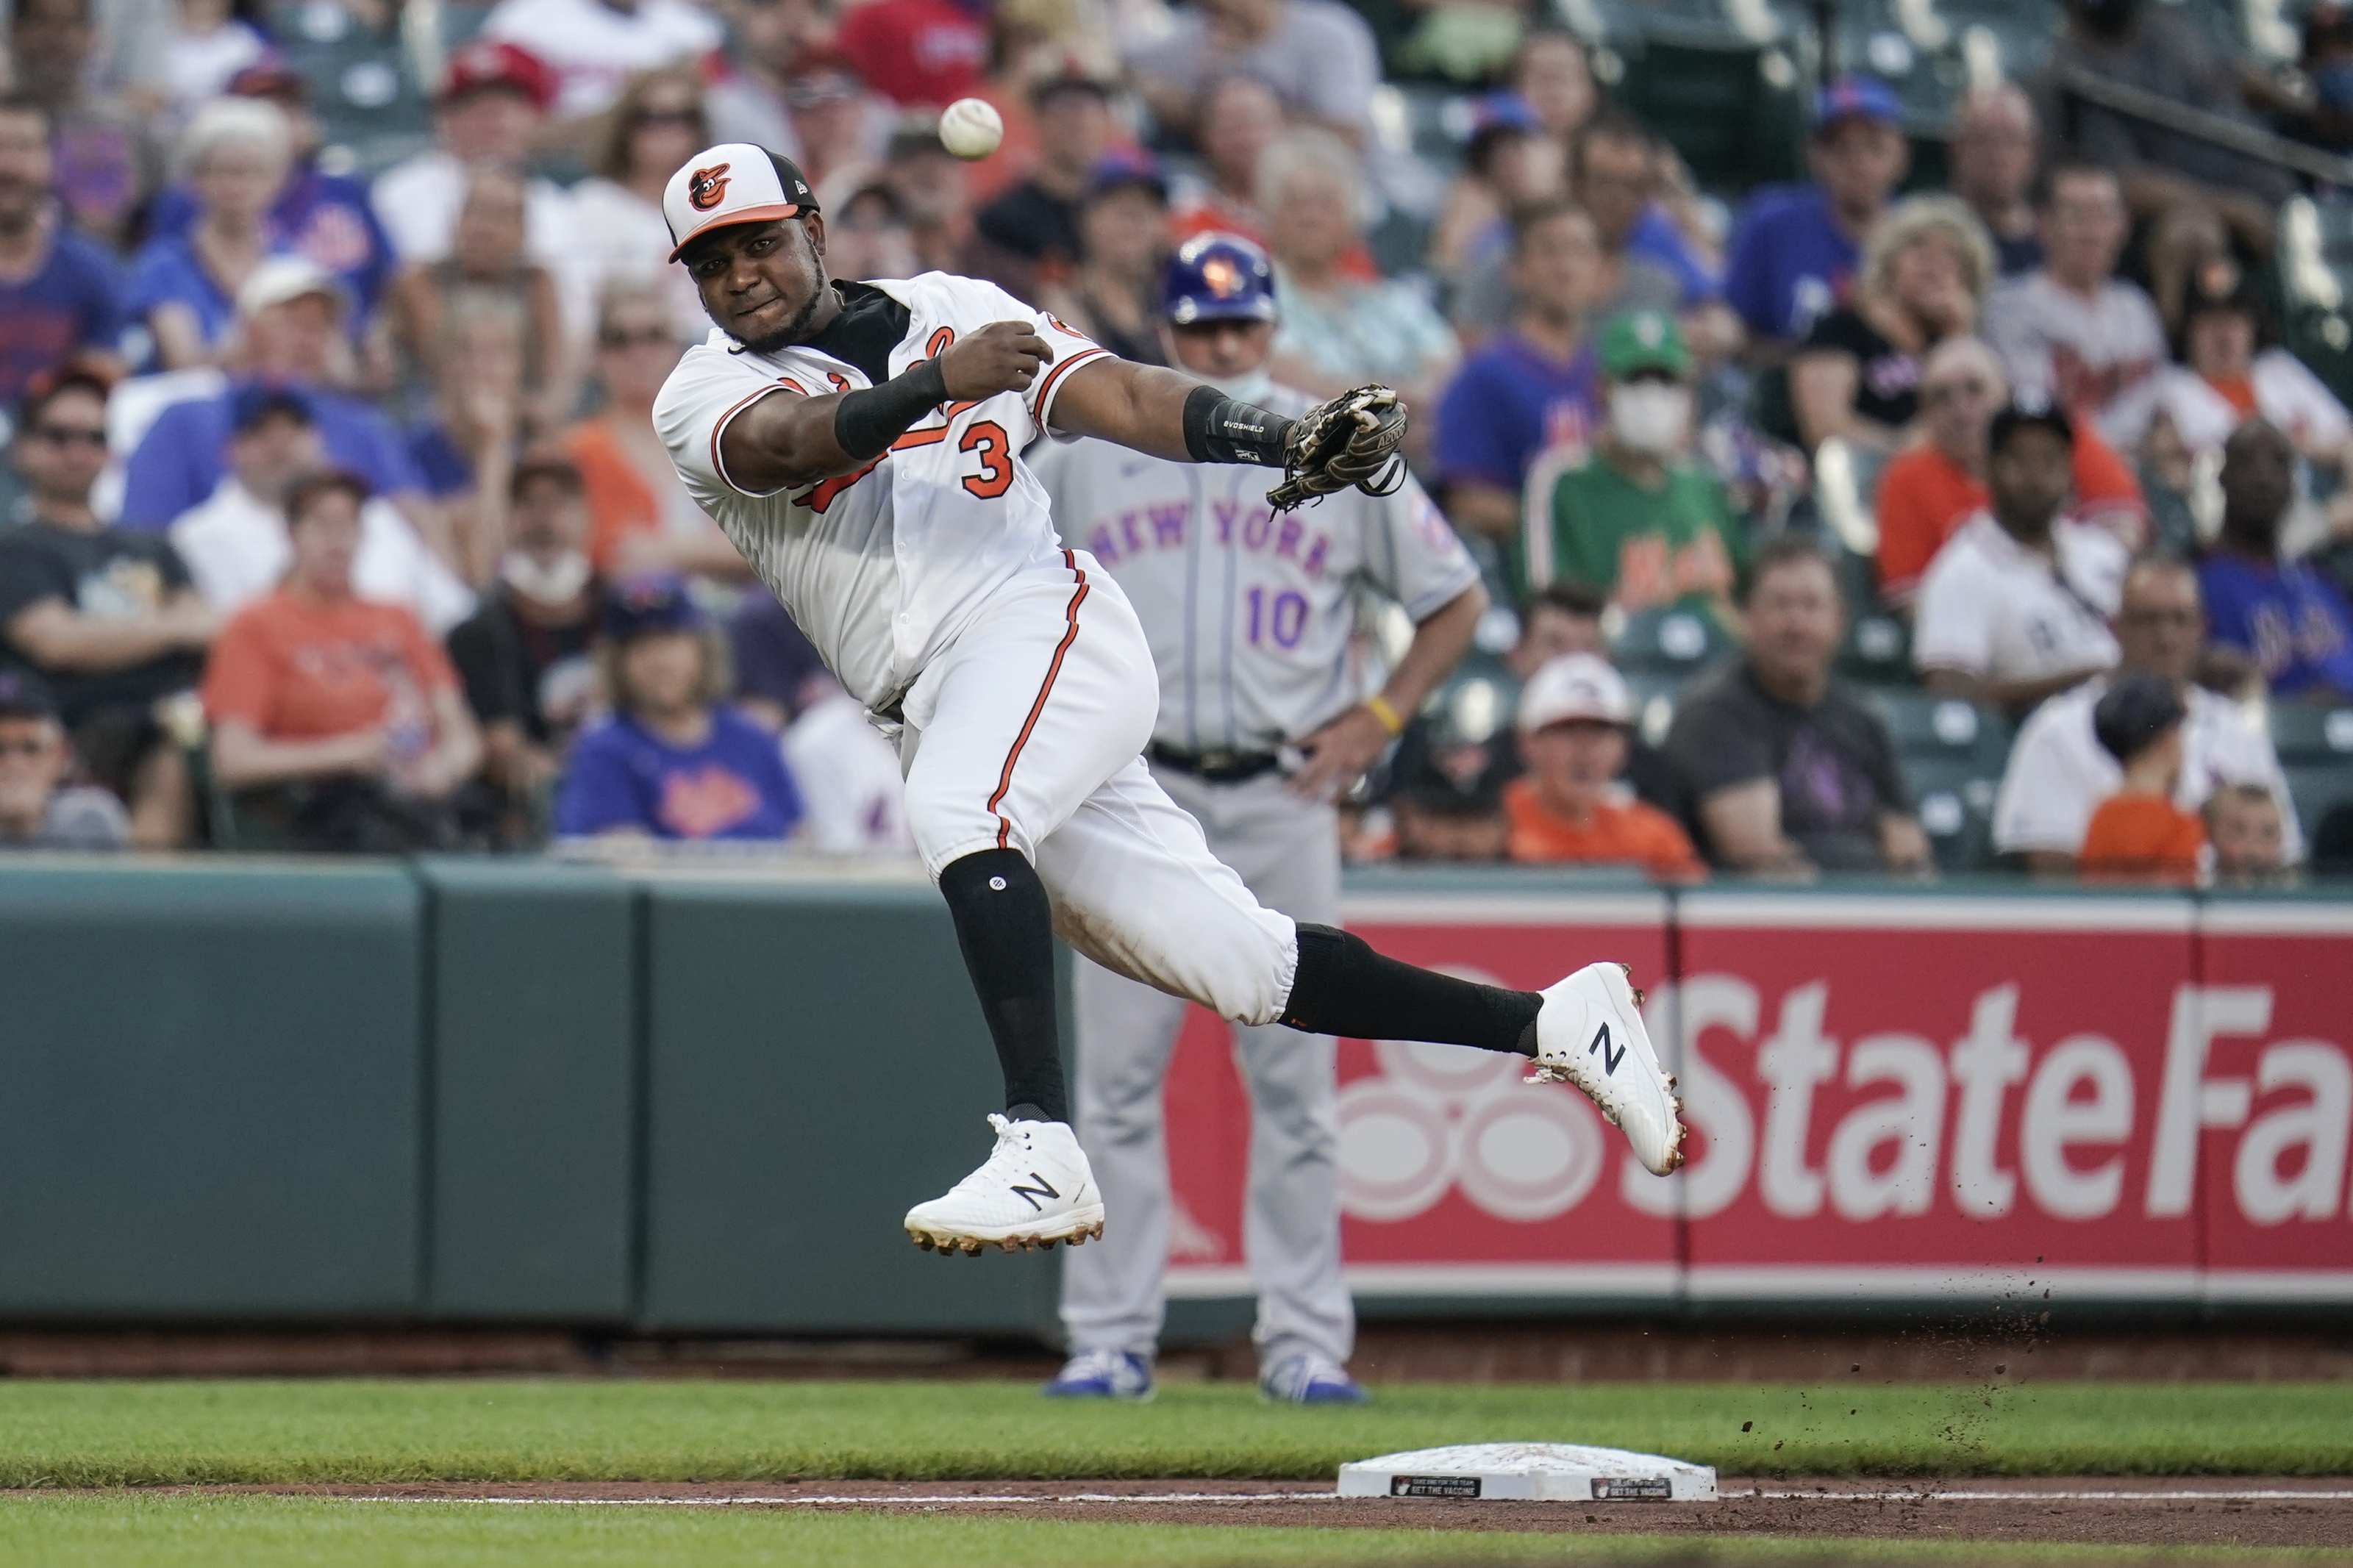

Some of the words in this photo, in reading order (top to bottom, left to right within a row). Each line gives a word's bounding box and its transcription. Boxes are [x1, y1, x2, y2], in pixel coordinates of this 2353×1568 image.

[959, 420, 1013, 500] 3
[1377, 424, 1405, 449] A2000
[1089, 499, 1193, 565] NEW
[1213, 498, 1328, 576] YORK
[1248, 587, 1310, 649] 10
[1427, 1486, 1441, 1495] THE
